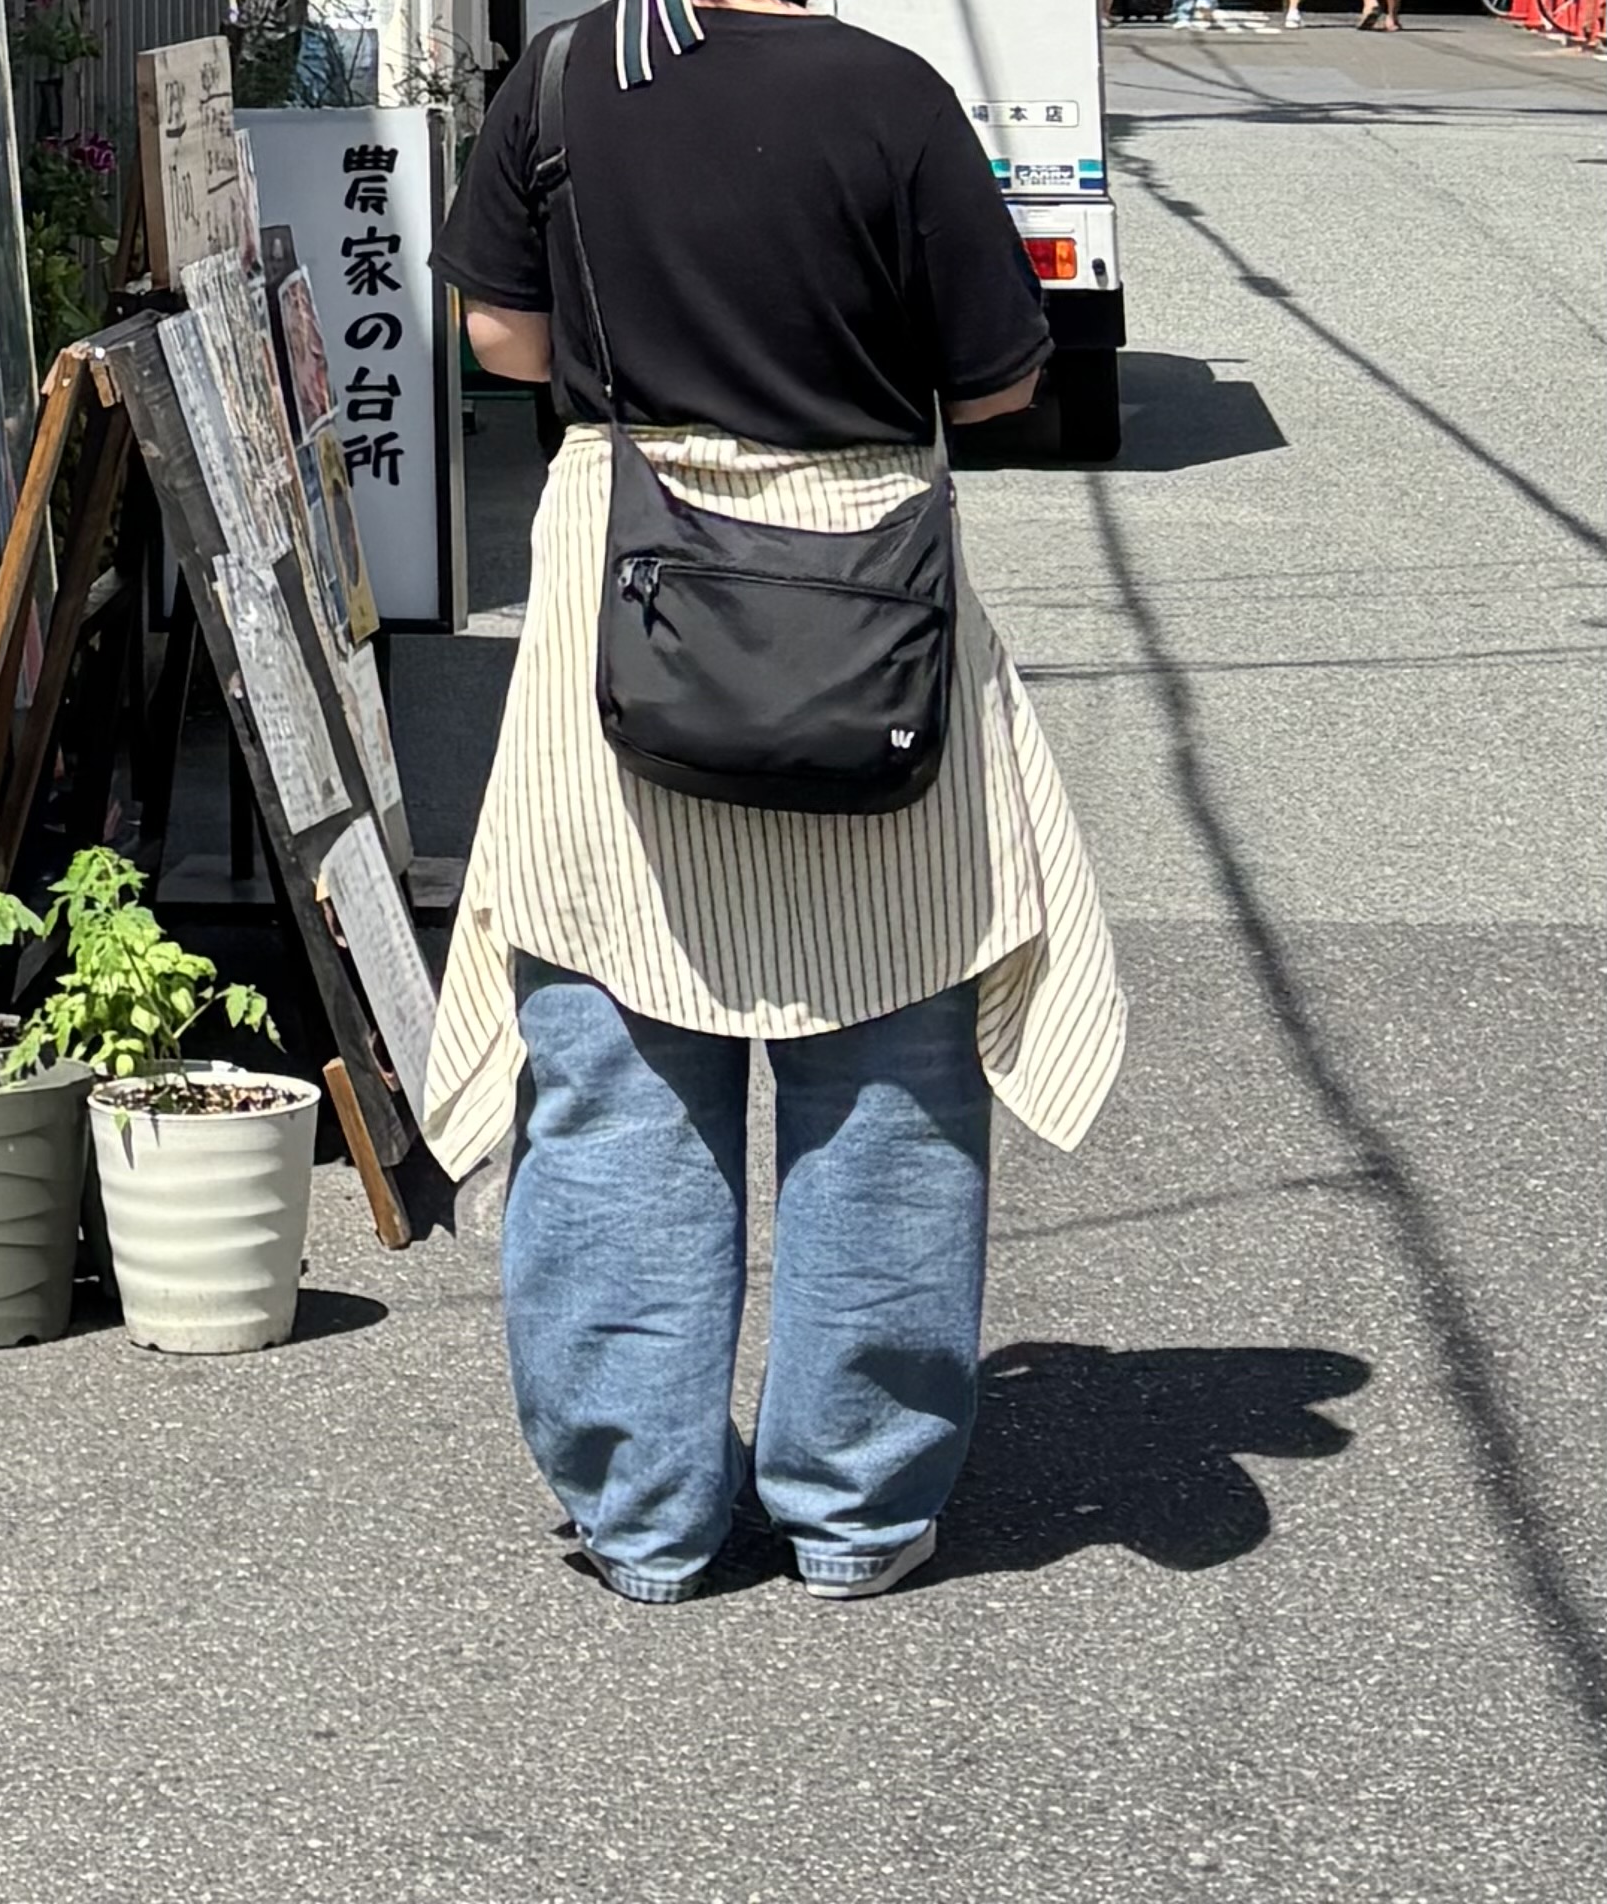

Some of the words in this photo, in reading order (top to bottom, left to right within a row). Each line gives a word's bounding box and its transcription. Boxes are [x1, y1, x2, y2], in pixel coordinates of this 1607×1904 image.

[341, 143, 404, 488] 農家の台所
